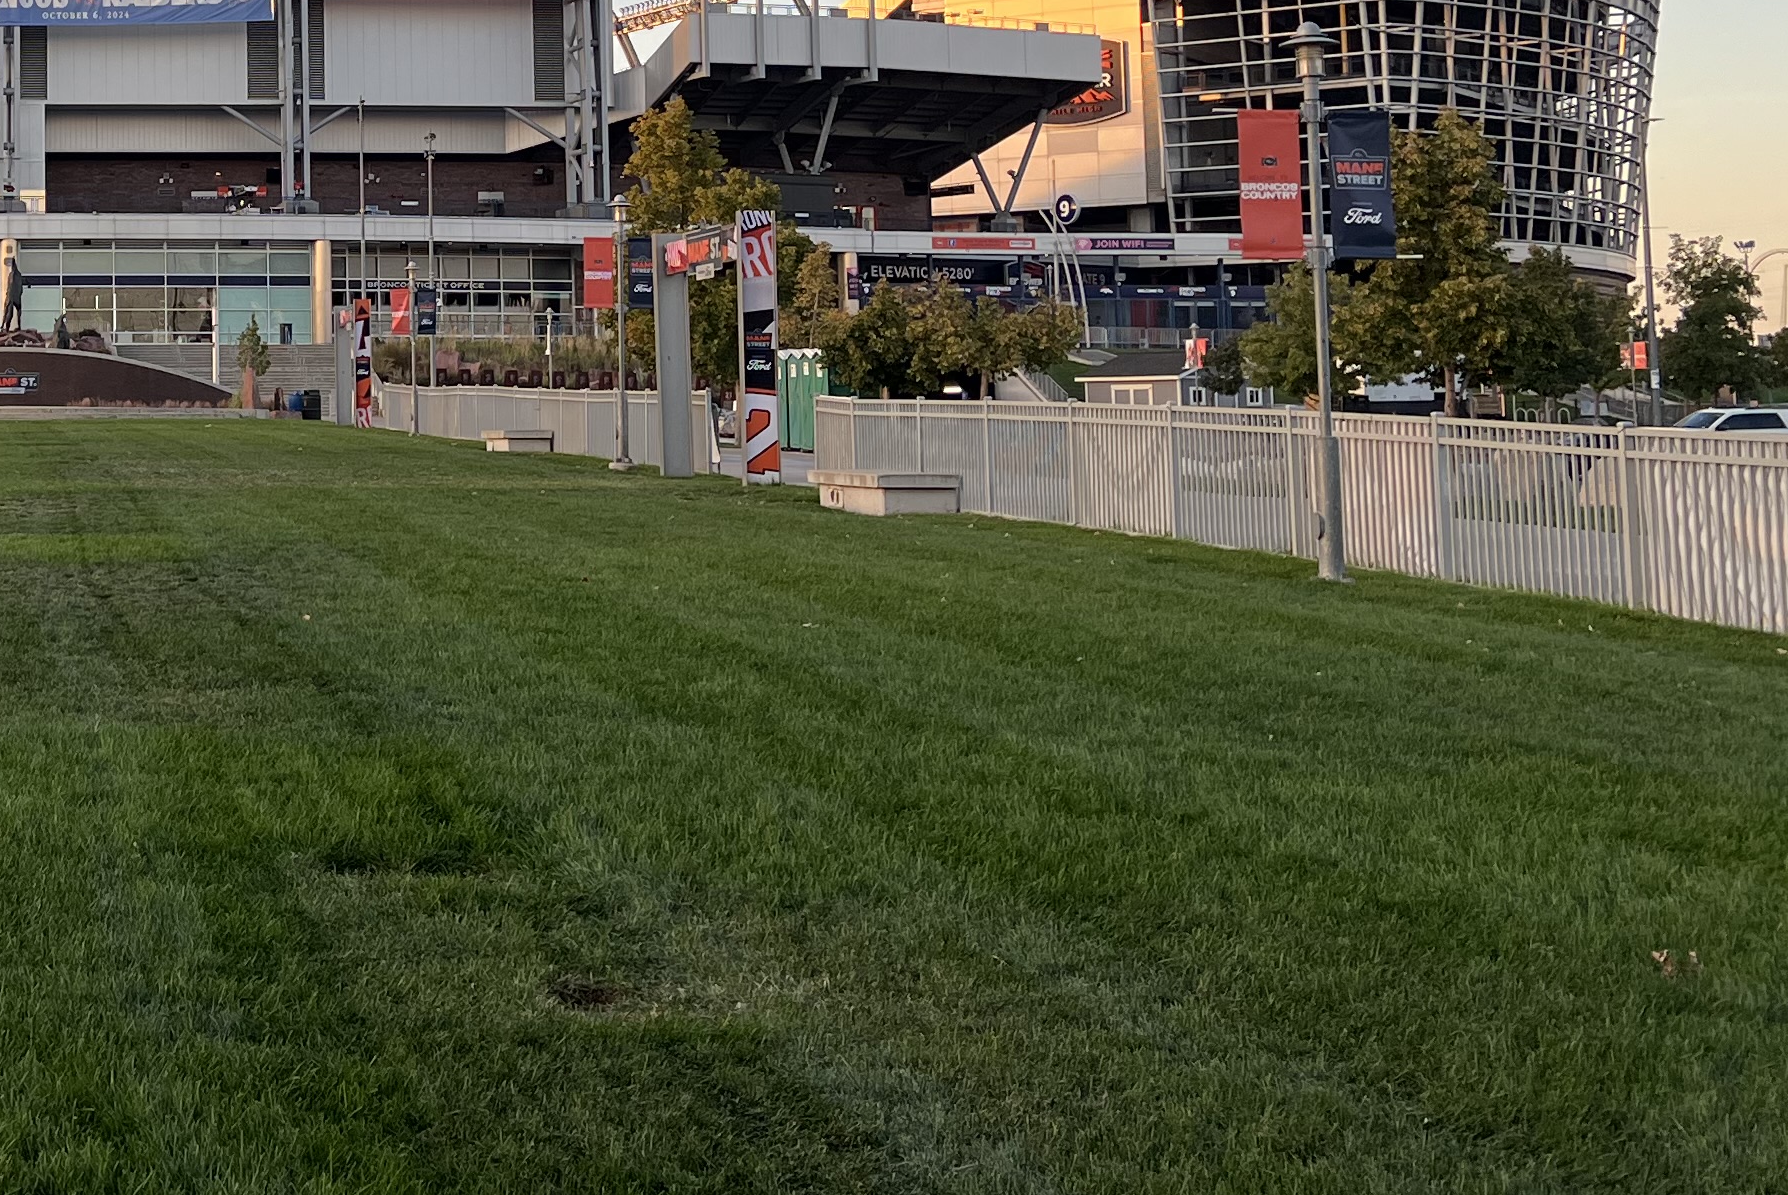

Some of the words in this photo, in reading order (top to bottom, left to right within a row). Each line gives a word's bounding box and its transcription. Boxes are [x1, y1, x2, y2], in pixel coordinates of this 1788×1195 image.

[42, 11, 88, 20] OCTOBER
[107, 10, 129, 19] 2024
[1336, 161, 1384, 174] MANE
[1337, 174, 1384, 185] STREET
[1241, 182, 1298, 192] BRONCOS
[1241, 191, 1298, 200] COUNTRY
[1059, 200, 1070, 217] 9
[1343, 207, 1382, 225] Ford
[1095, 239, 1119, 249] JOIN
[1121, 239, 1144, 248] WIFI
[746, 359, 772, 371] Ford
[20, 377, 38, 387] ST.
